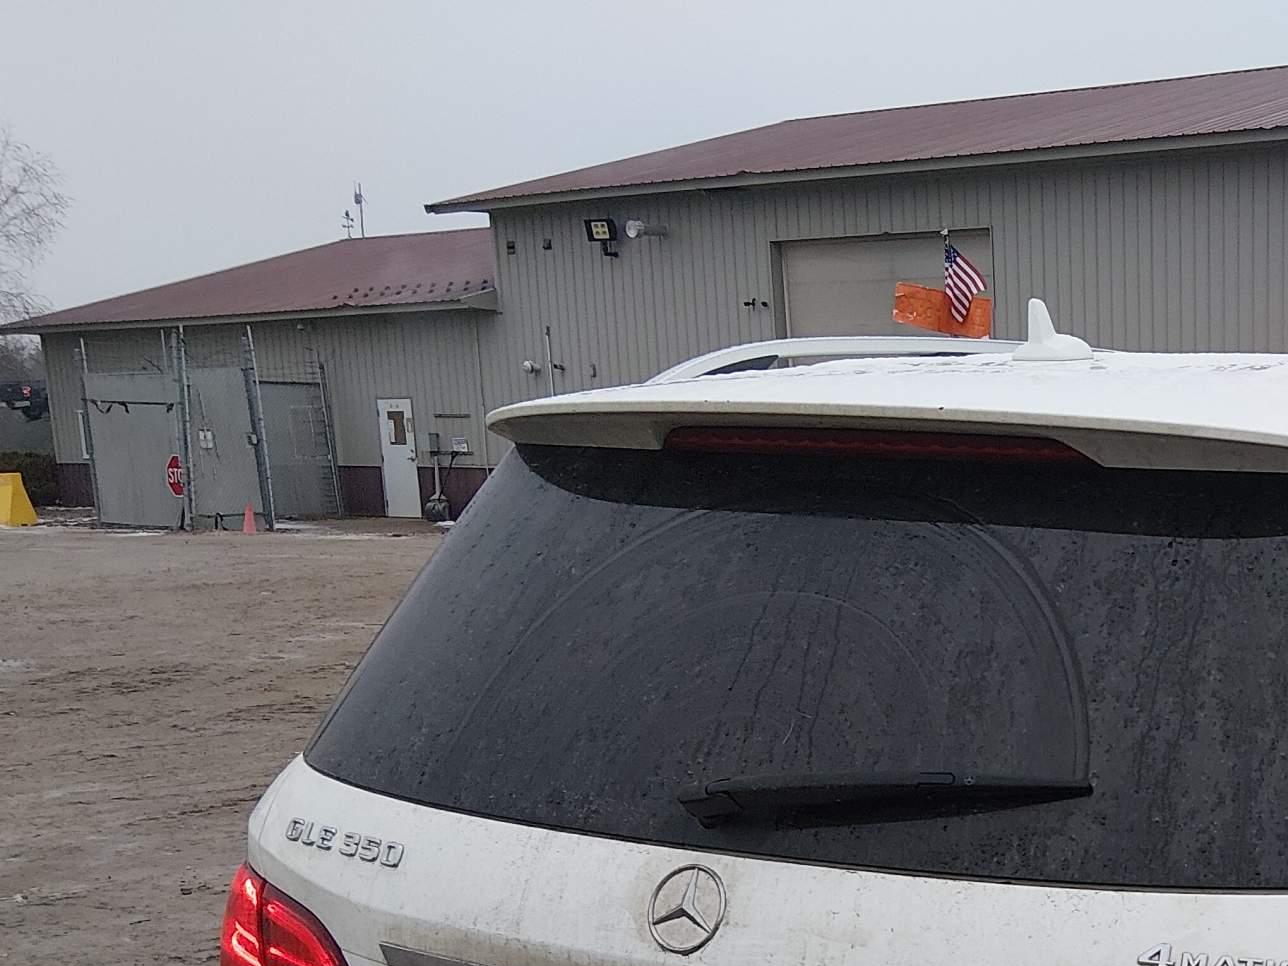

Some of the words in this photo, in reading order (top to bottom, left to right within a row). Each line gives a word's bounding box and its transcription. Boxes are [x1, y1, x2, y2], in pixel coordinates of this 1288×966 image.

[168, 468, 184, 484] STO
[286, 817, 338, 851] GLE
[339, 831, 405, 869] 350
